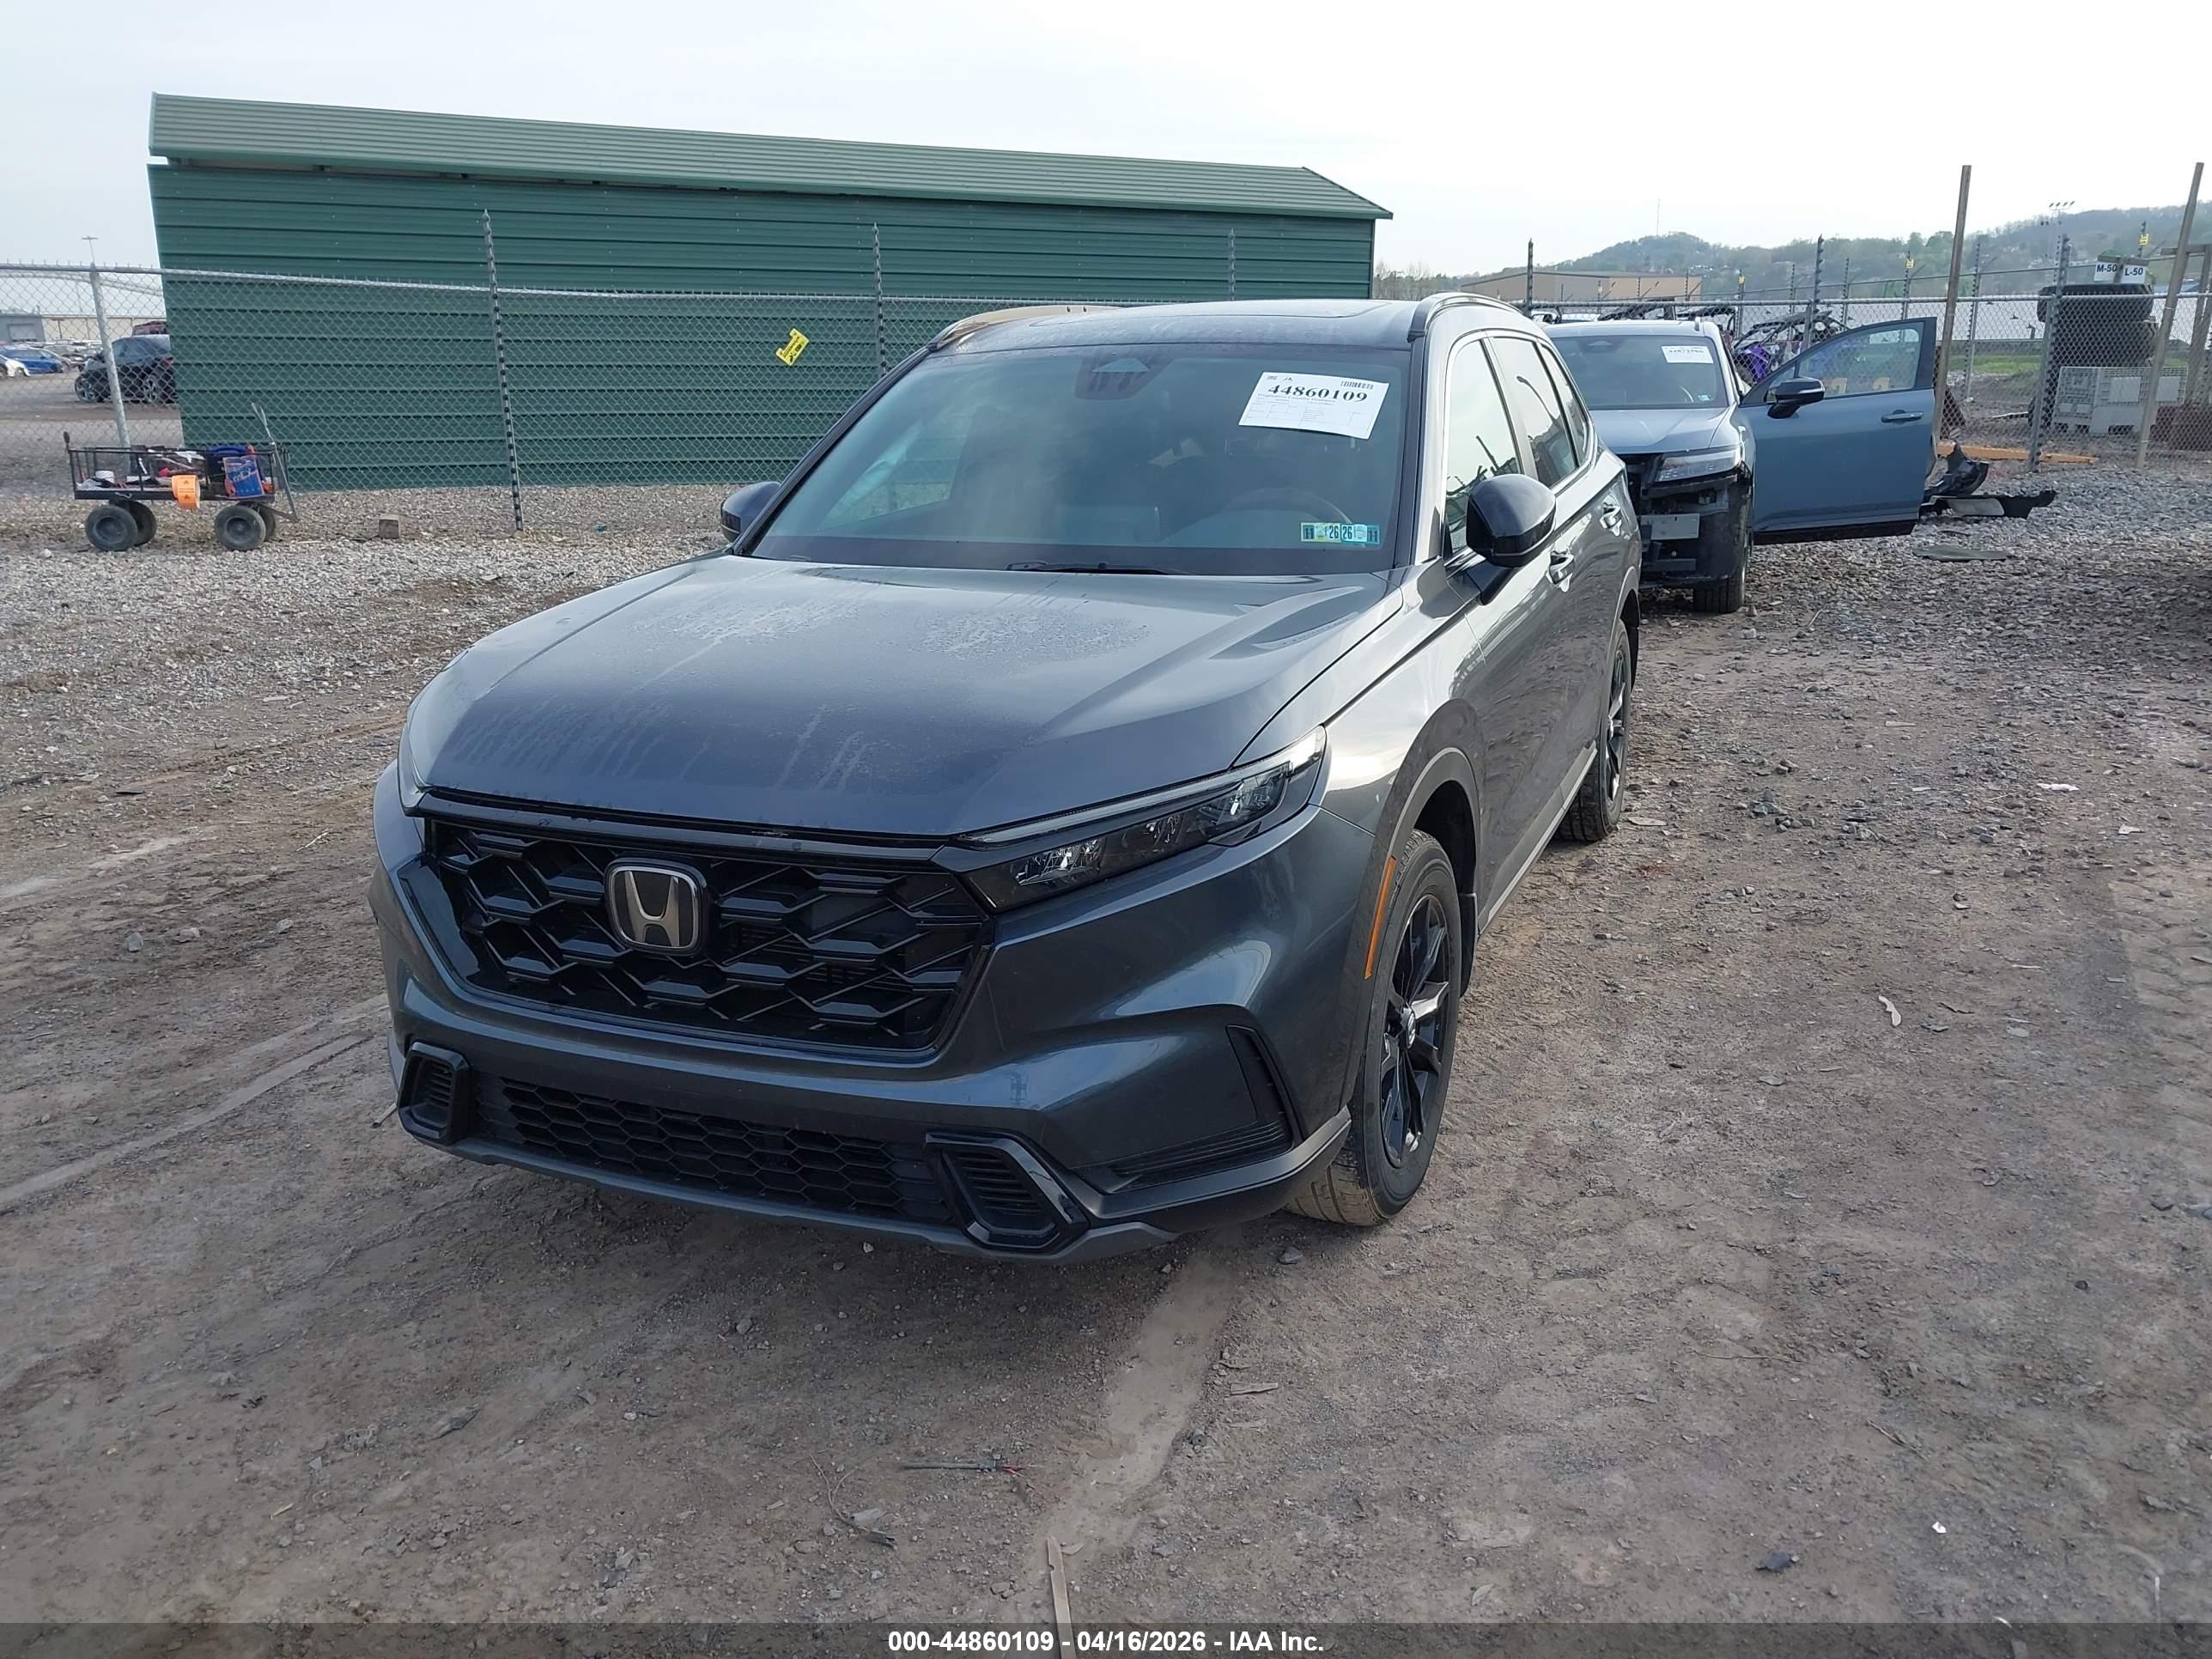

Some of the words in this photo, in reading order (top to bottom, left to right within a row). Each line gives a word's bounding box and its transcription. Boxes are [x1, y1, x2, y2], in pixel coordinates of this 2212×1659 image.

[2096, 264, 2118, 273] M-50
[2124, 267, 2144, 276] L-50
[1267, 384, 1368, 403] 44860109
[1328, 526, 1340, 539] 26
[1342, 526, 1353, 539] 26
